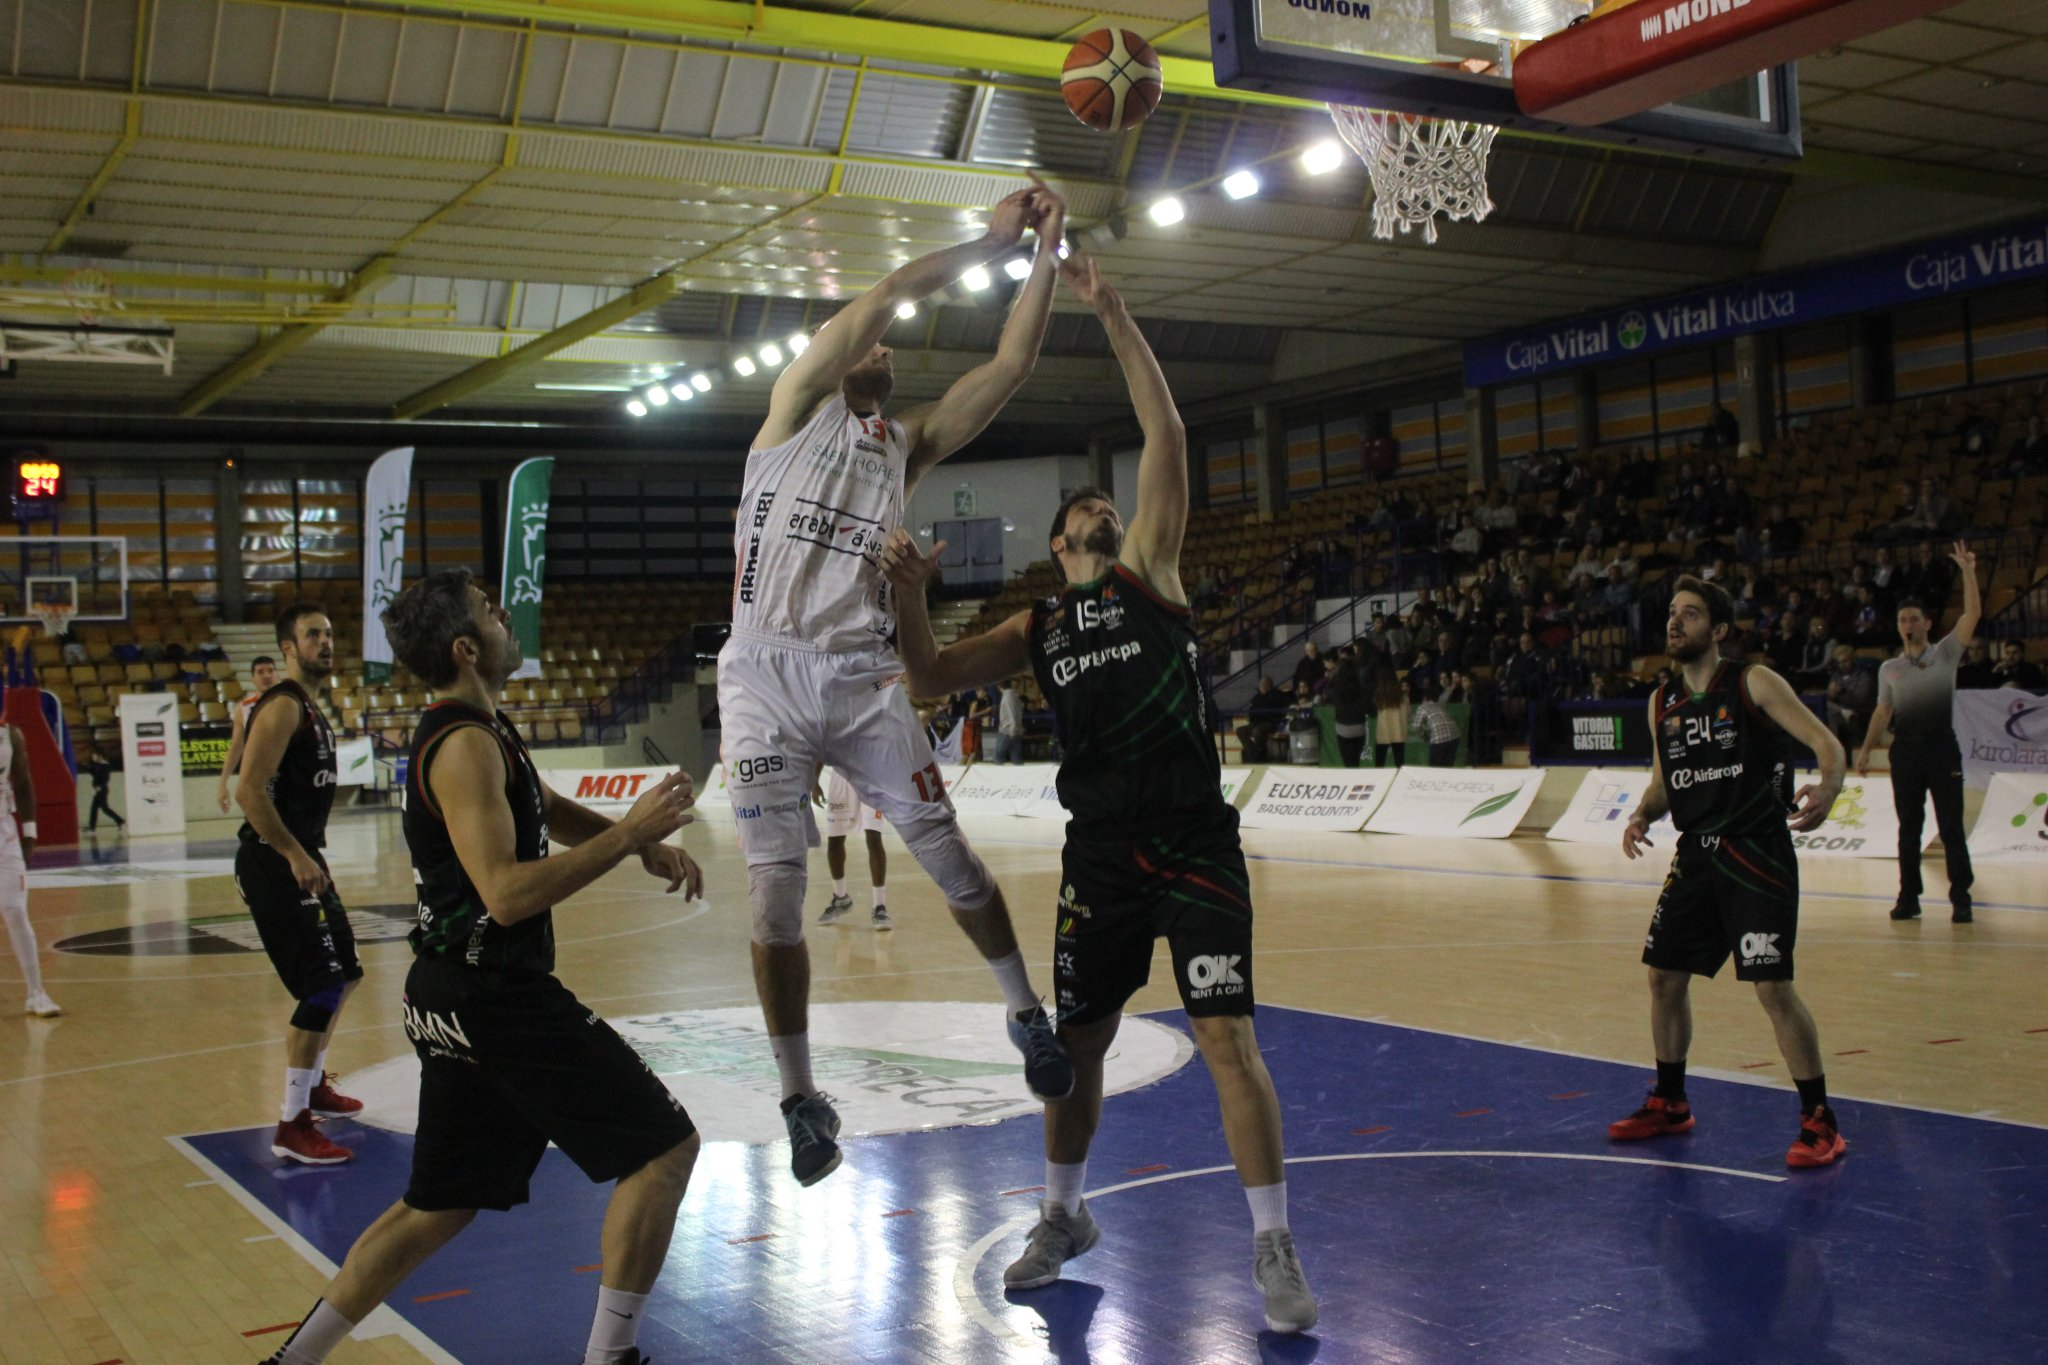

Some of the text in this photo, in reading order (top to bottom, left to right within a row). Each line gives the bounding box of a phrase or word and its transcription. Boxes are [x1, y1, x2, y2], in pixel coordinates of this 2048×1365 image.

[1905, 252, 1967, 292] Caja
[1505, 290, 1795, 372] Caja Vital Vital Kutxa
[812, 444, 848, 466] SAEN
[25, 479, 56, 497] 24
[1572, 717, 1614, 734] VITORIA
[1686, 715, 1711, 746] 24
[1573, 734, 1615, 751] GASTEIZ
[739, 755, 784, 783] gas
[912, 762, 944, 801] 13
[575, 774, 648, 799] MQT
[1267, 783, 1348, 800] EUSKADI
[1256, 803, 1362, 818] BASQUE COUNTRY
[1740, 932, 1782, 959] OK
[1187, 954, 1244, 989] OK
[1190, 985, 1244, 1000] RENT A CAR
